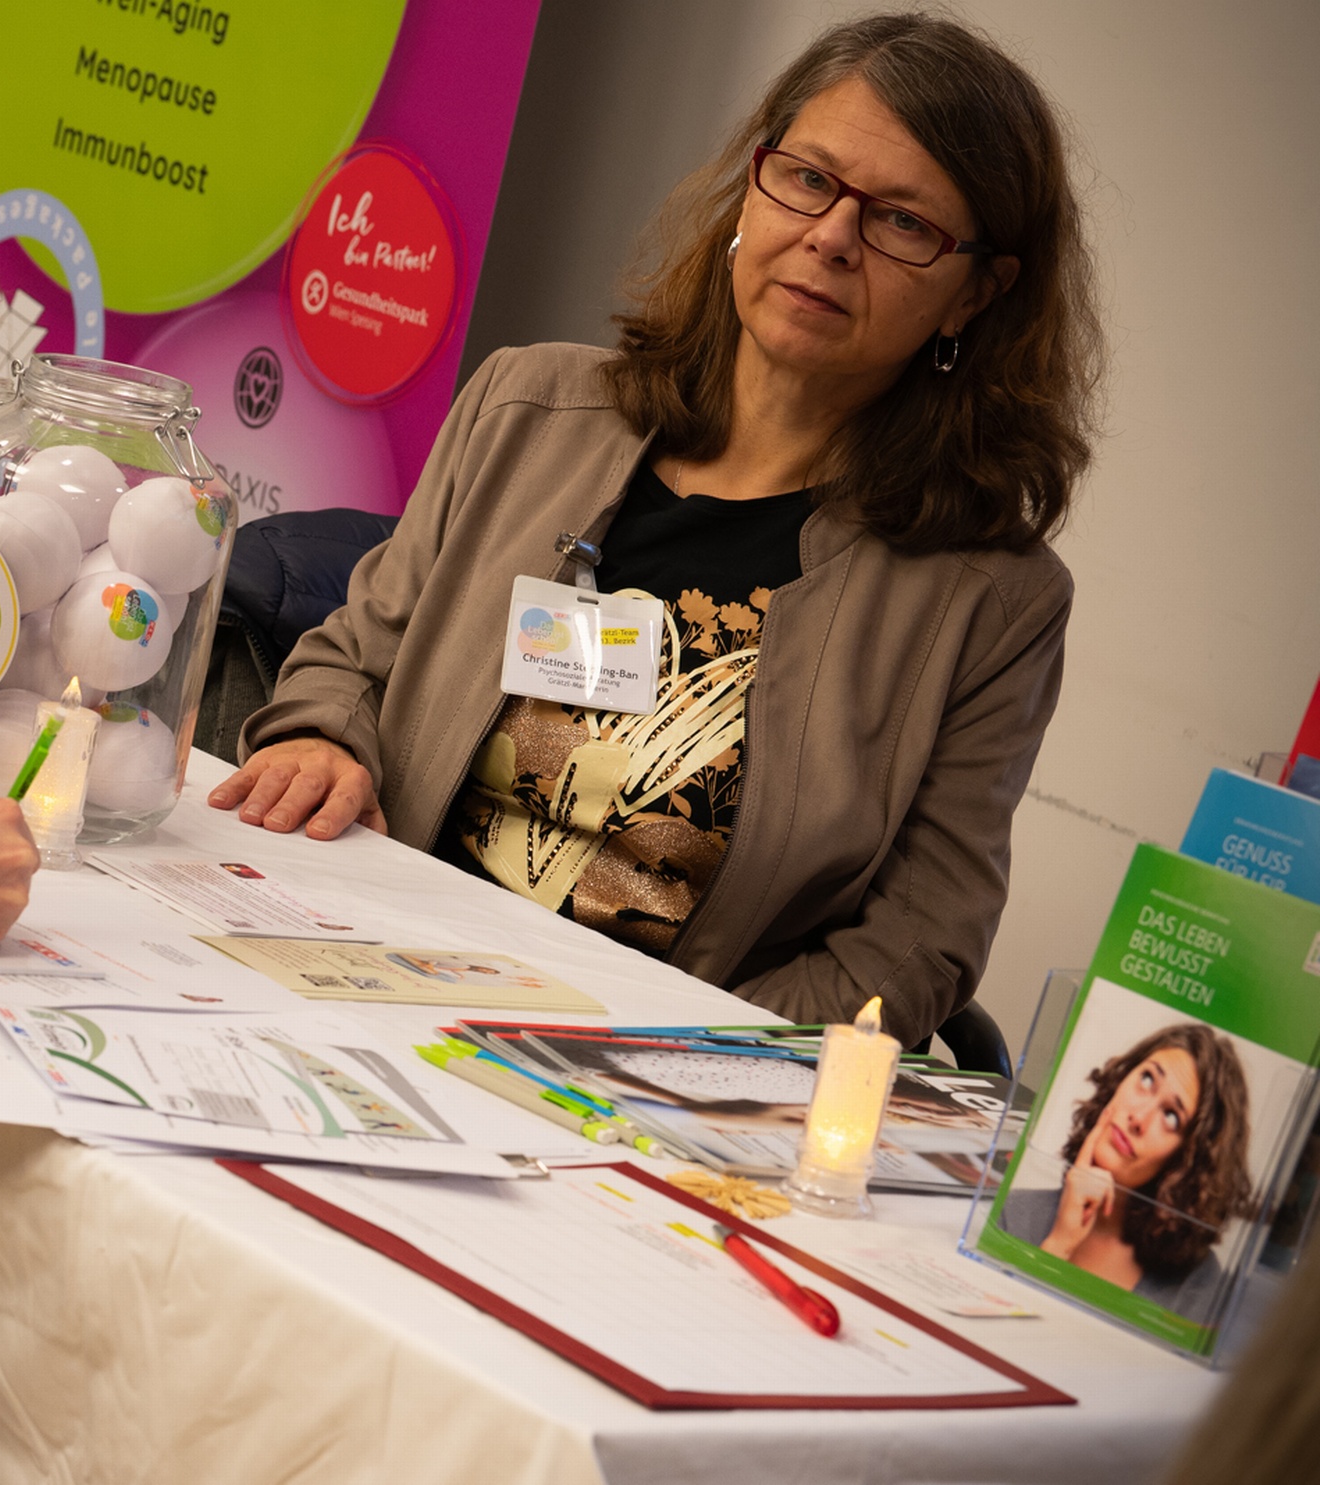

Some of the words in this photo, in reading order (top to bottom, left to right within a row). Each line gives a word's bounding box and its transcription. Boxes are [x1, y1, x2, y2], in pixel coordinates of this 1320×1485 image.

[96, 0, 230, 45] -Aging
[75, 45, 217, 115] Menopause
[53, 117, 208, 194] Immunboost
[327, 191, 374, 237] Ich
[344, 234, 369, 266] bin
[373, 241, 437, 272] Partner!
[332, 281, 429, 327] Gesundheitspark
[599, 628, 639, 637] rätzl-Team
[522, 652, 570, 669] Christine
[1222, 834, 1294, 875] GENUSS
[1128, 929, 1214, 977] BEWUSST
[1138, 904, 1178, 936] DAS
[1176, 921, 1232, 957] LEBEN
[1120, 953, 1216, 1007] GESTALTEN
